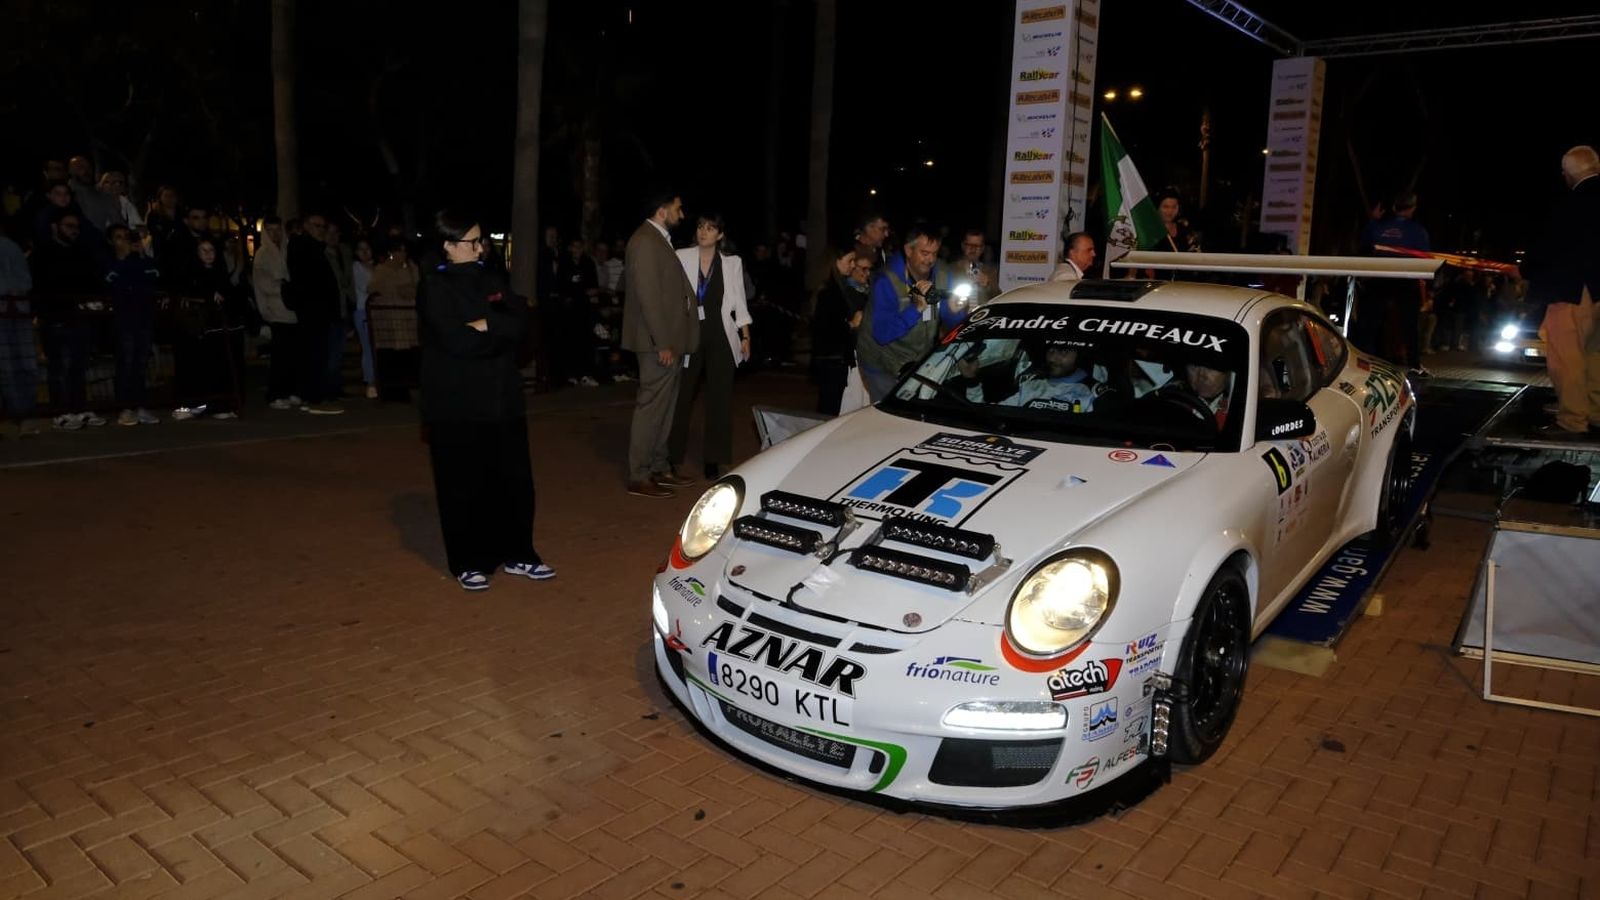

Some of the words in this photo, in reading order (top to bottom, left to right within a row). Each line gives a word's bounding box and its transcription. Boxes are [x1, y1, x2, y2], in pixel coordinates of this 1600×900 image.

[989, 315, 1069, 331] André
[1078, 318, 1228, 353] CHIPEAUX
[1271, 419, 1304, 436] LOURDES
[840, 498, 906, 517] THERMO
[1126, 633, 1158, 655] RUIZ
[702, 621, 867, 698] AZNAR
[906, 661, 1000, 686] frionature
[1049, 662, 1105, 692] atech
[721, 663, 779, 706] 8290
[795, 689, 850, 727] KTL
